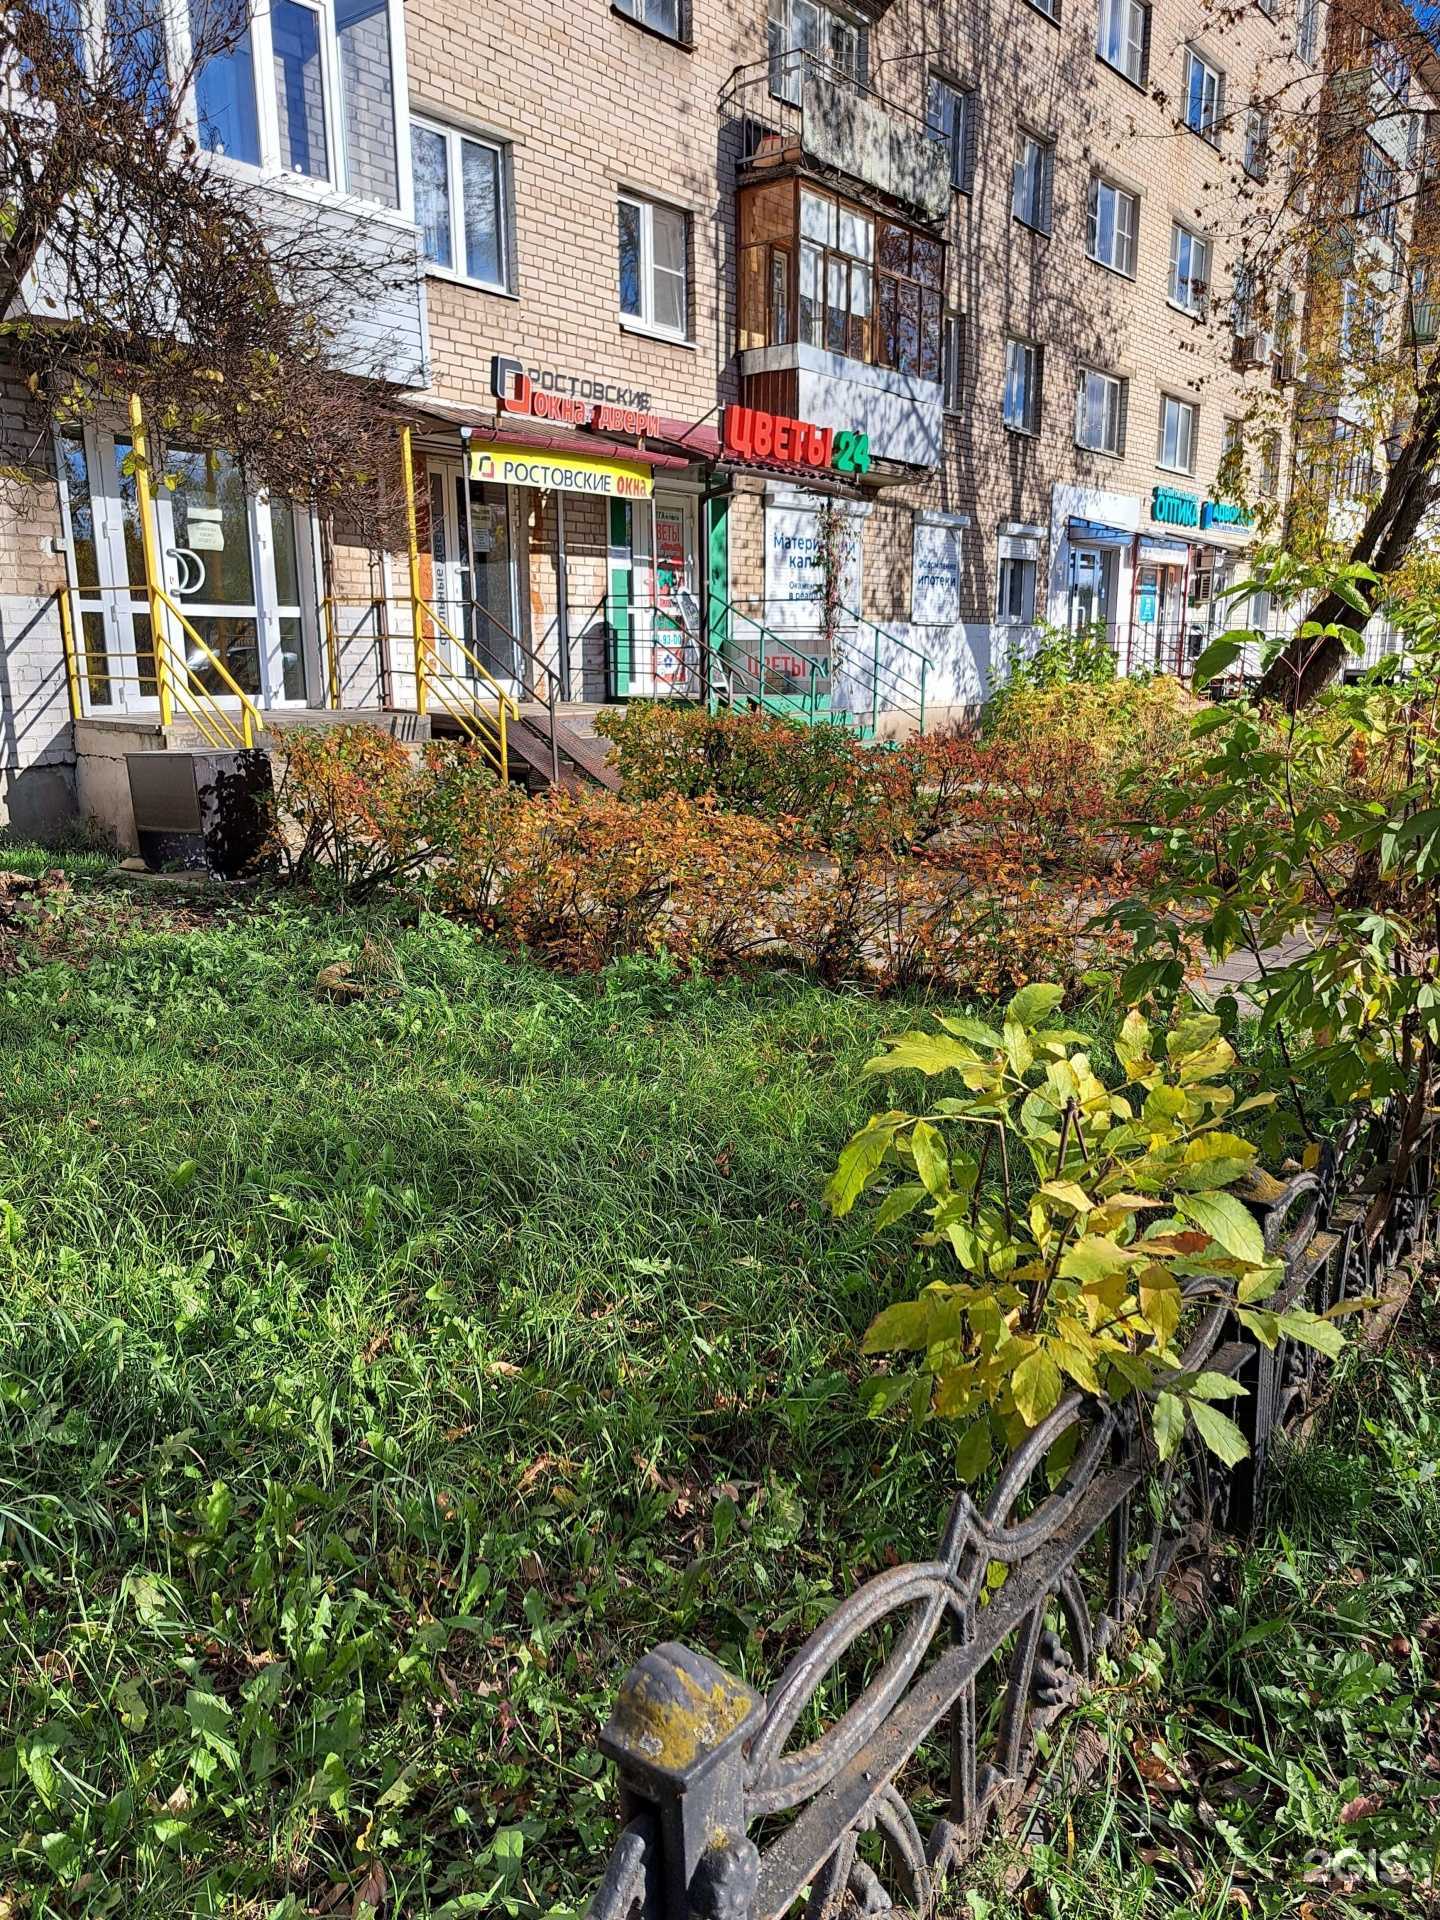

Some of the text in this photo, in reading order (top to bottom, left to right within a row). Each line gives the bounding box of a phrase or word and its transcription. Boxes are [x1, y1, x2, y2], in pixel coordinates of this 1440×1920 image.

[528, 368, 652, 409] РОСТОВСКИЕ
[726, 405, 871, 474] ЦВЕТЫ 24
[504, 461, 611, 492] РОСТОВСКИЕ
[1156, 495, 1199, 526] ОПТИКА
[656, 522, 680, 543] ВЕТЫ
[436, 568, 447, 646] стльные
